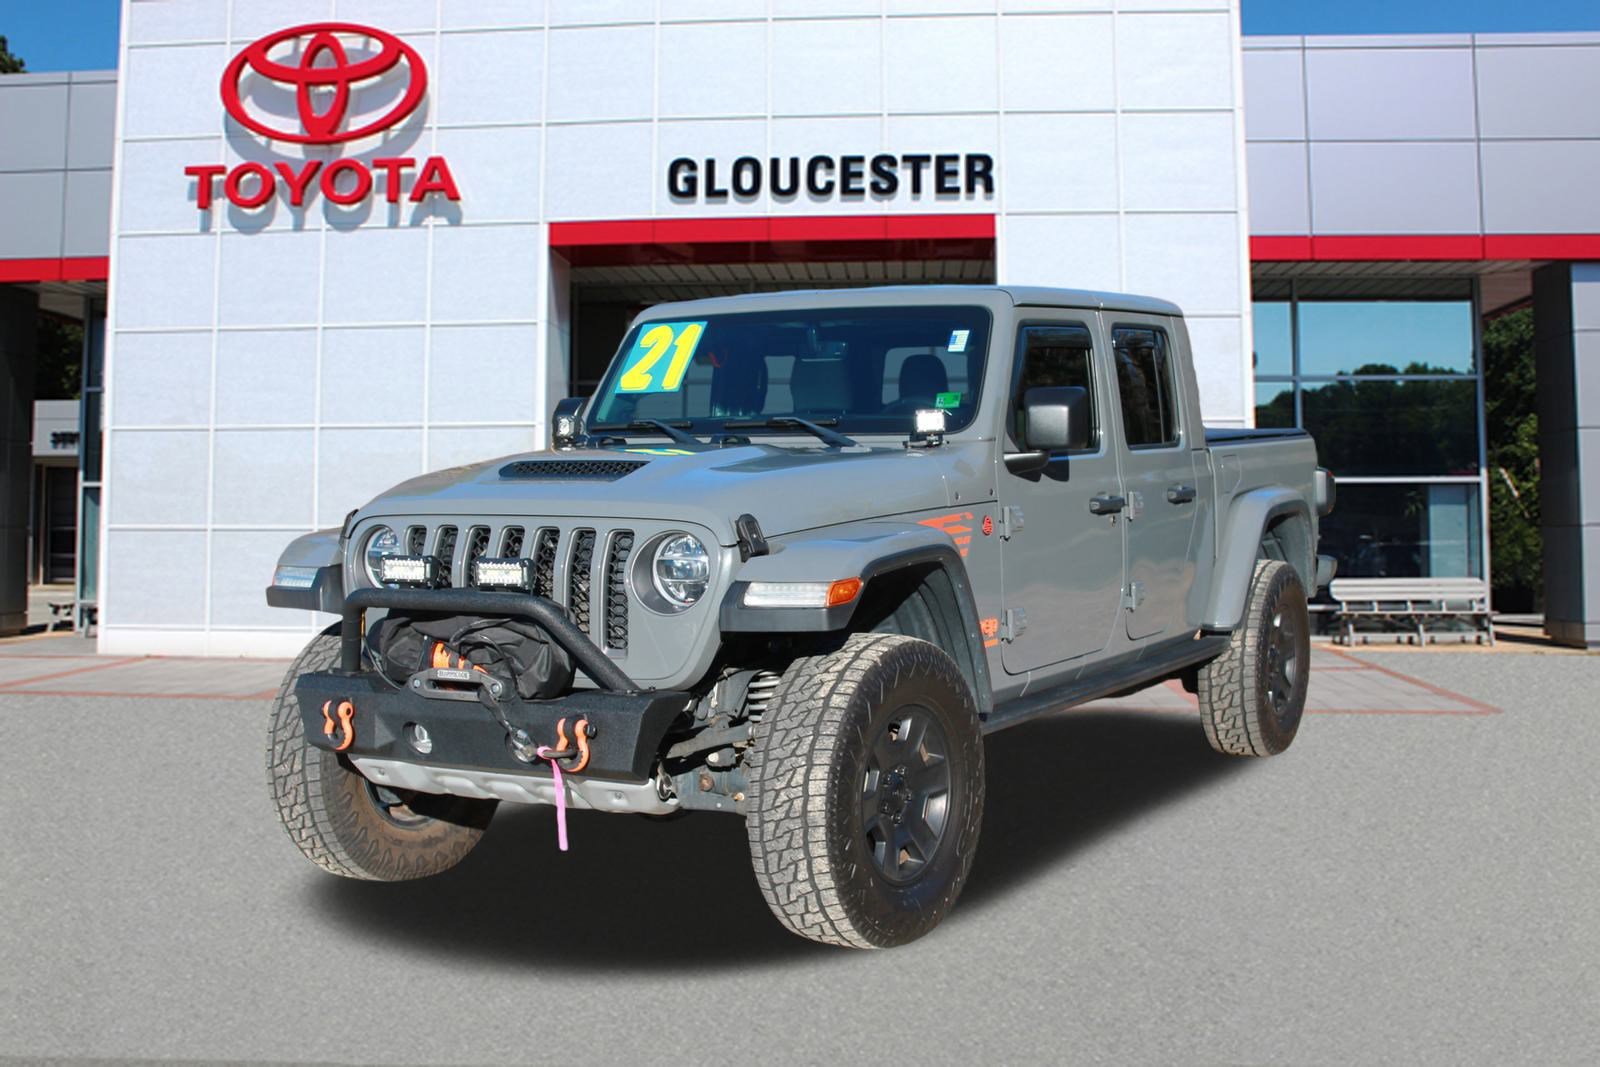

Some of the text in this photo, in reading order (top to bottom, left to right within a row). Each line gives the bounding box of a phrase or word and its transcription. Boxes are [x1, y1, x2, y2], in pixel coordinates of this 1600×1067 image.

[185, 156, 461, 210] TOYOTA
[668, 154, 994, 199] GLOUCESTER
[619, 323, 703, 391] 21
